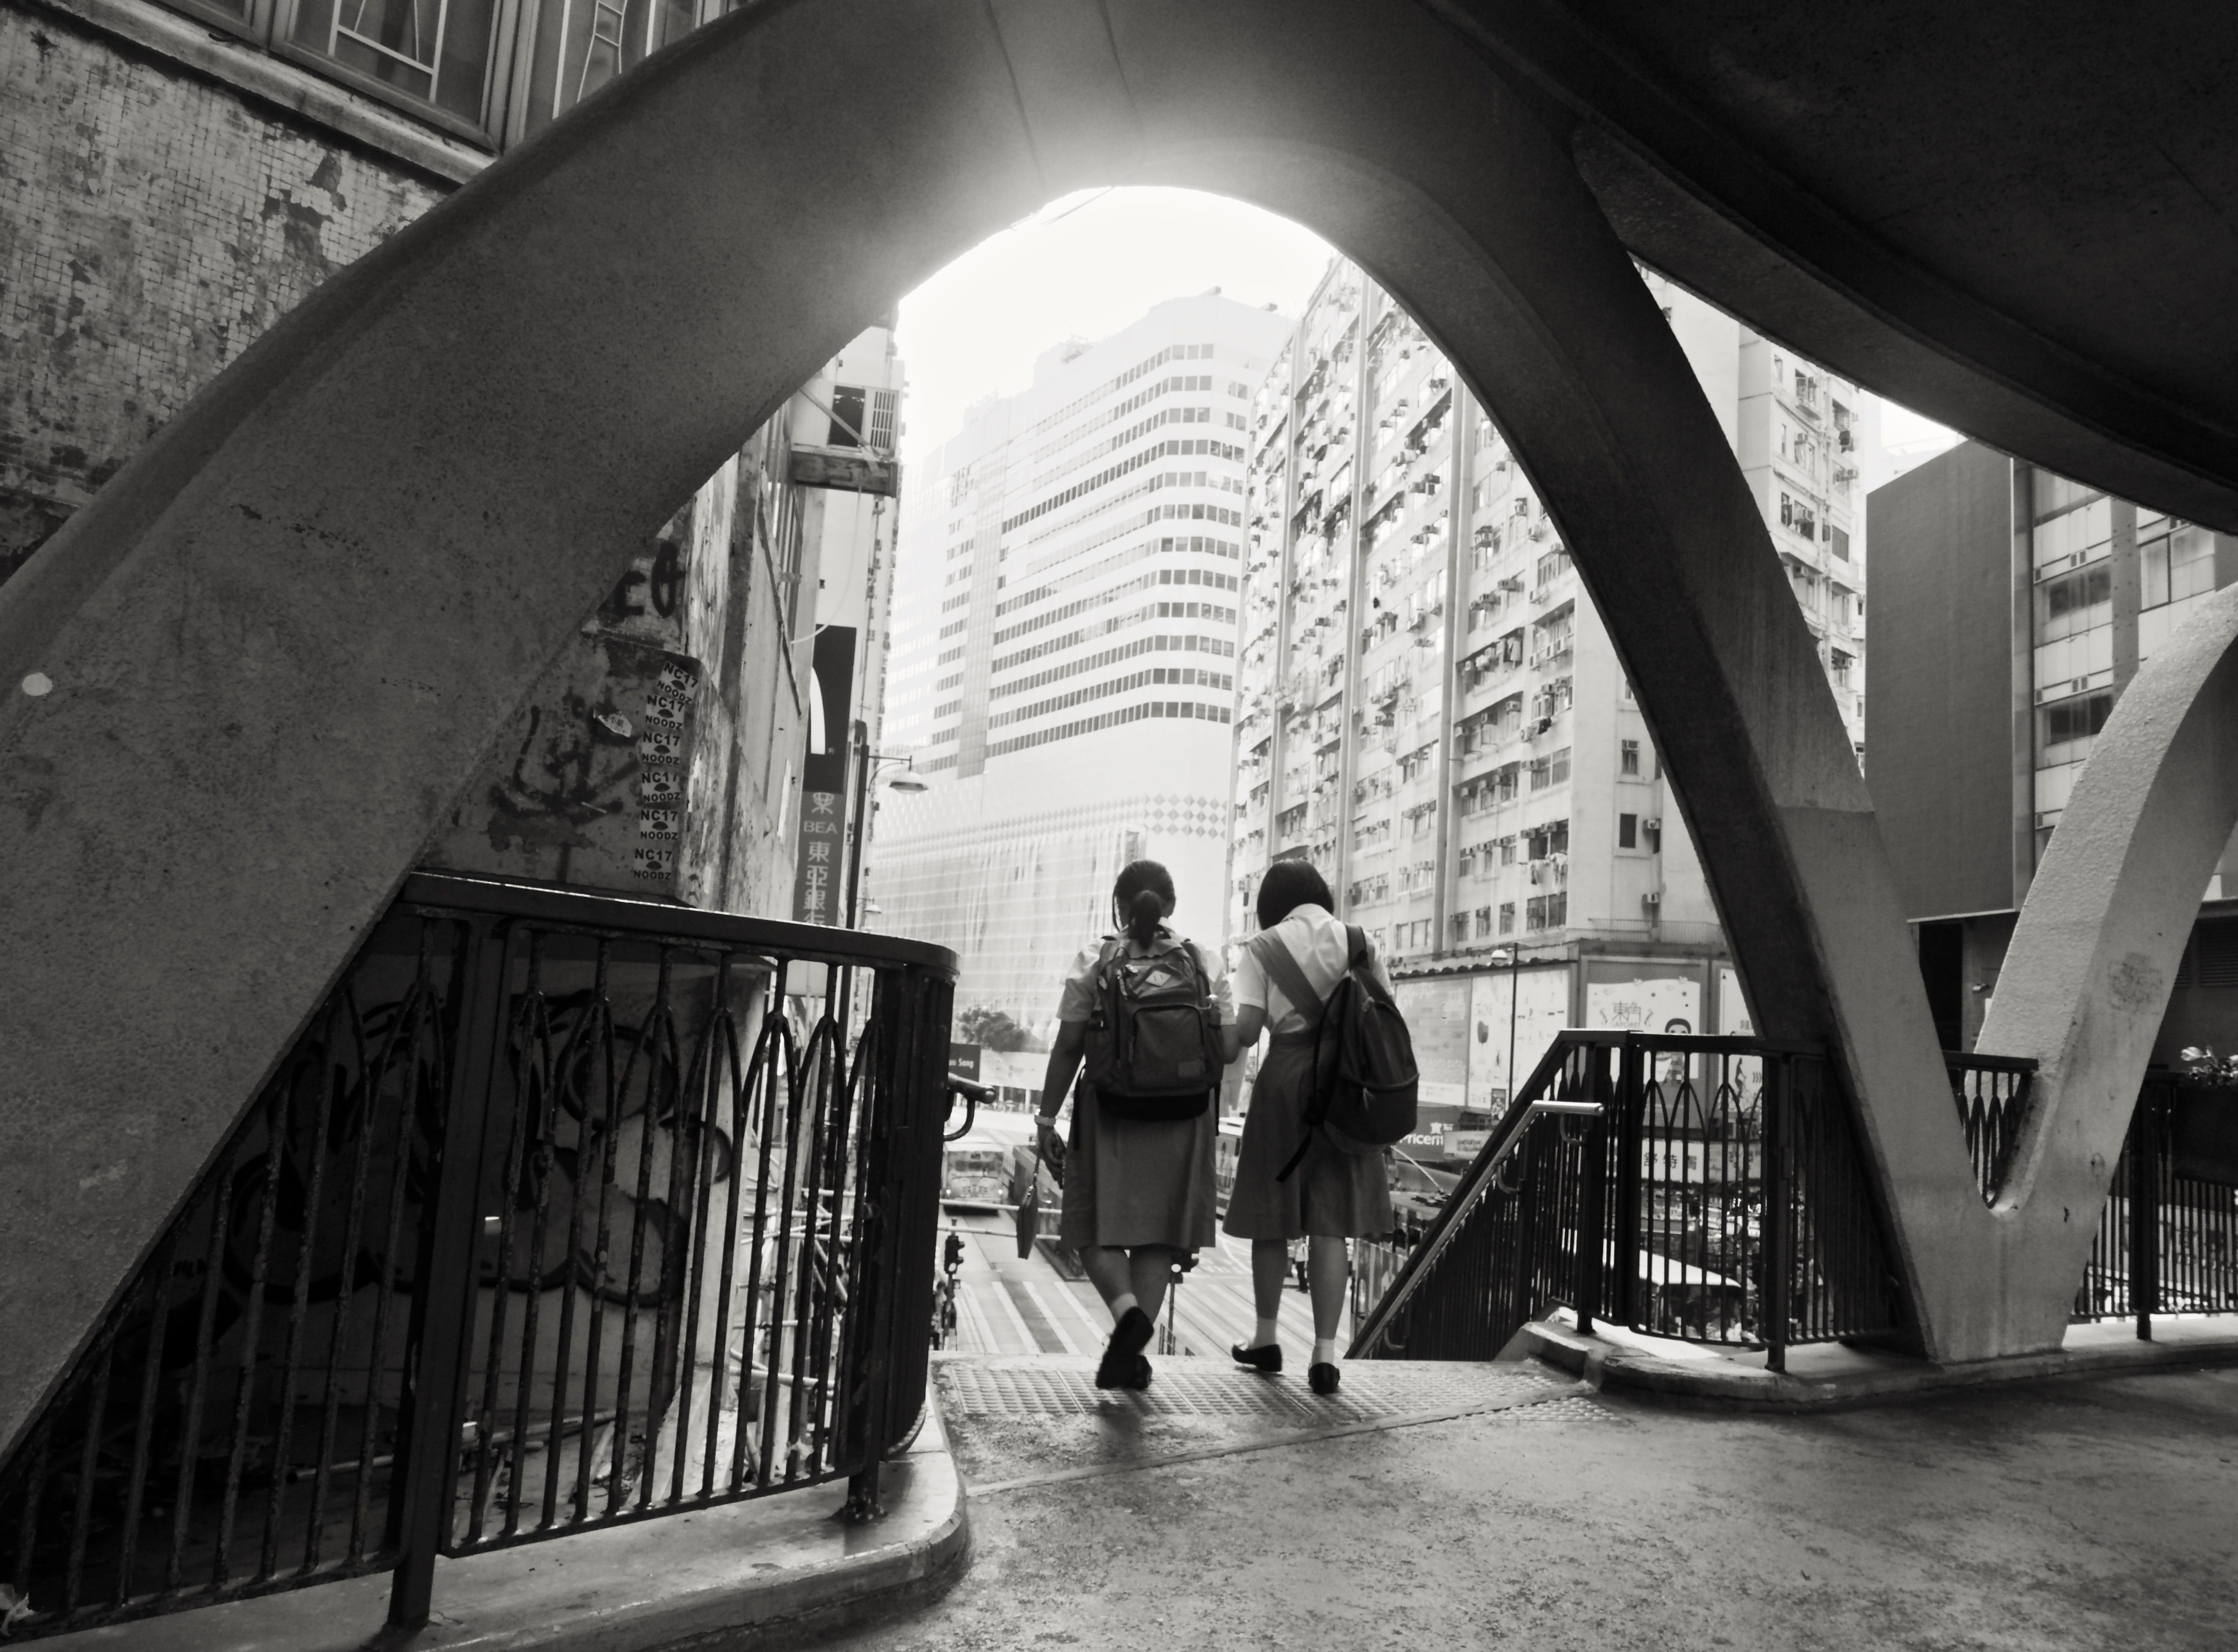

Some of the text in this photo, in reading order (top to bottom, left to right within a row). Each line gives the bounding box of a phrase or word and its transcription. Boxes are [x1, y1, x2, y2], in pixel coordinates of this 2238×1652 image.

[663, 662, 698, 687] NC17
[656, 681, 692, 705] NOODZ
[646, 694, 684, 712] NC17
[645, 715, 682, 730] NOODZ
[643, 732, 680, 746] NC17
[642, 754, 679, 765] NOODZ
[643, 792, 680, 802] NOODZ
[640, 810, 677, 821] NC17
[803, 820, 838, 834] BEA
[640, 831, 678, 840] NOODZ
[635, 847, 672, 862] NC17
[633, 869, 672, 880] NOODZ
[958, 1058, 974, 1069] Sang
